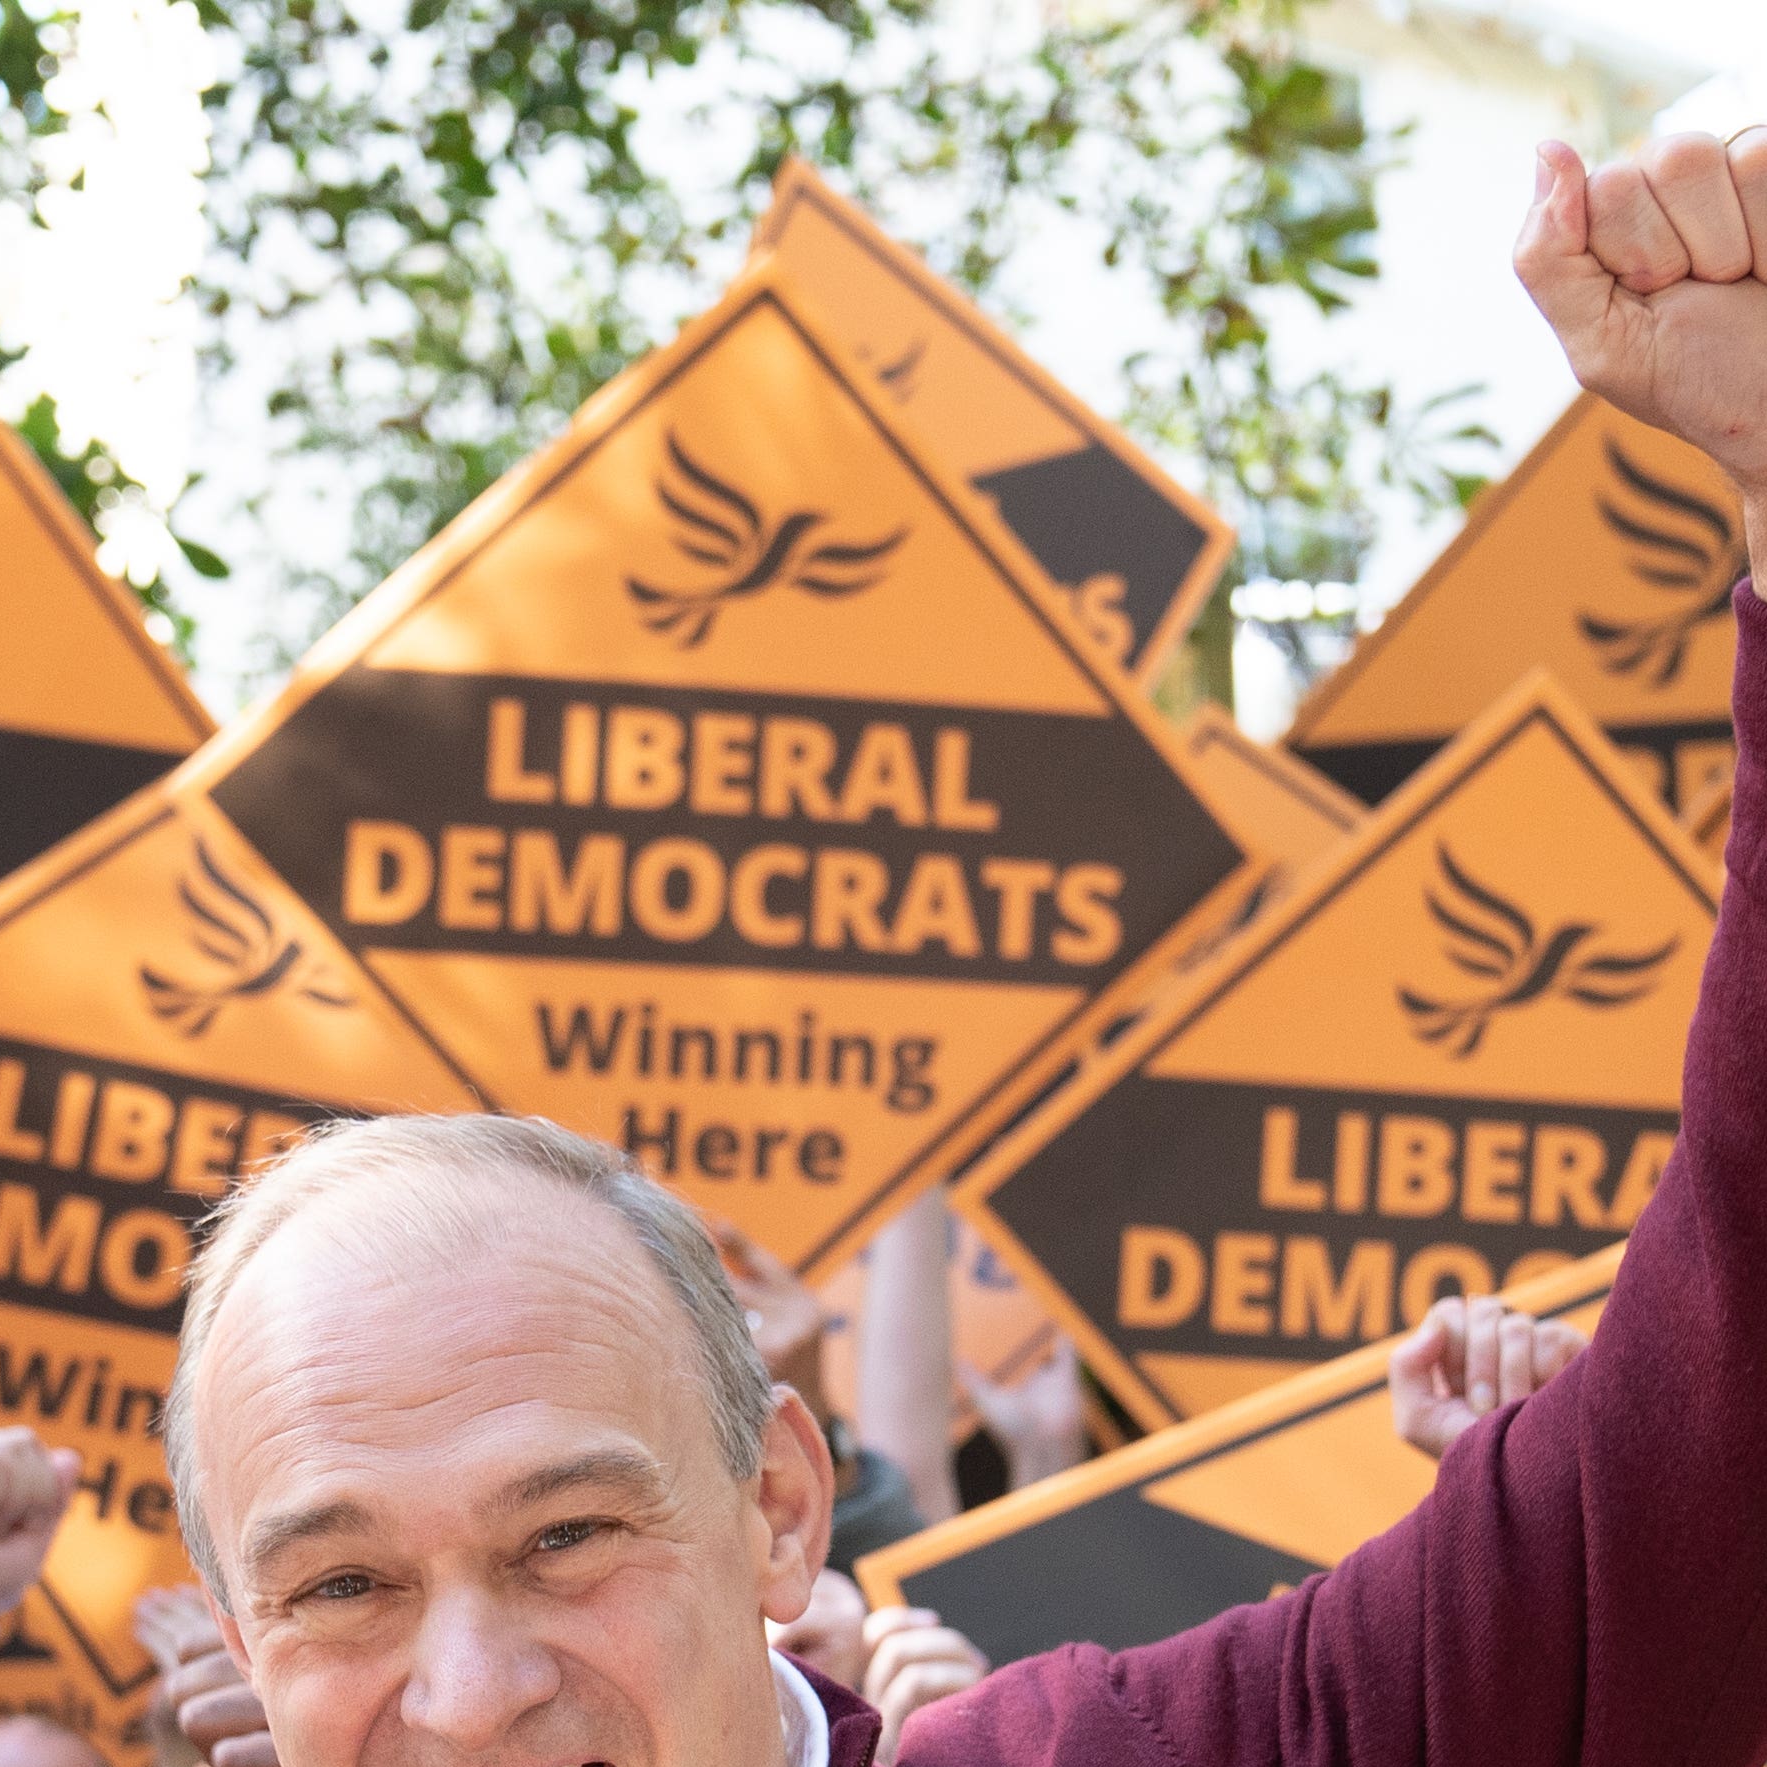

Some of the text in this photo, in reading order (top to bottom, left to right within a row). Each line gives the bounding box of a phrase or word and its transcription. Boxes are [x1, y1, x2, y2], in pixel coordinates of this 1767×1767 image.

[487, 697, 999, 834] LIBERAL
[342, 820, 1125, 966] DEMOCRATS
[537, 1002, 939, 1113] Winning
[621, 1104, 846, 1184] Here
